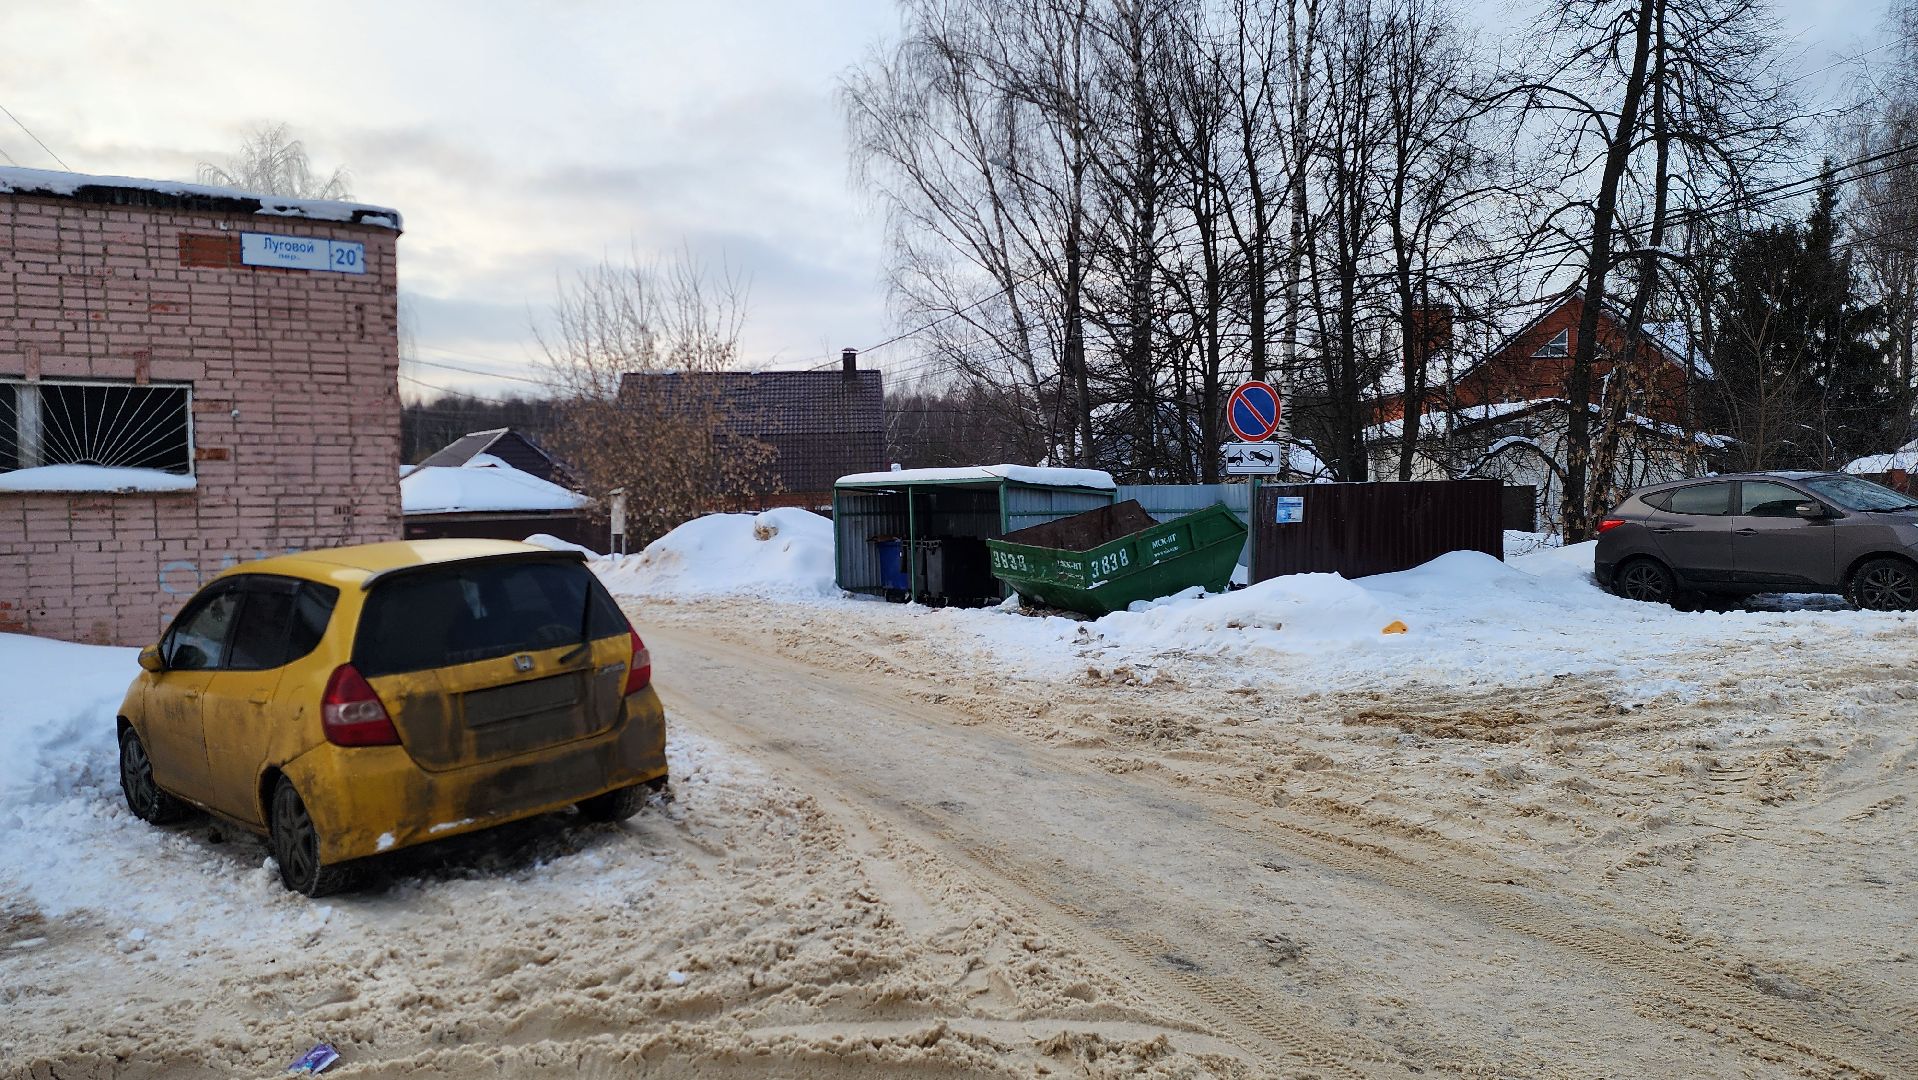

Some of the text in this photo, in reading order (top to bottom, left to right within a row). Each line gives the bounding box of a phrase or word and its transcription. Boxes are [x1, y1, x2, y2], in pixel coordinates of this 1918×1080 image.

[264, 237, 314, 253] Луговой
[993, 551, 1027, 572] 3838
[1091, 548, 1129, 578] 3838
